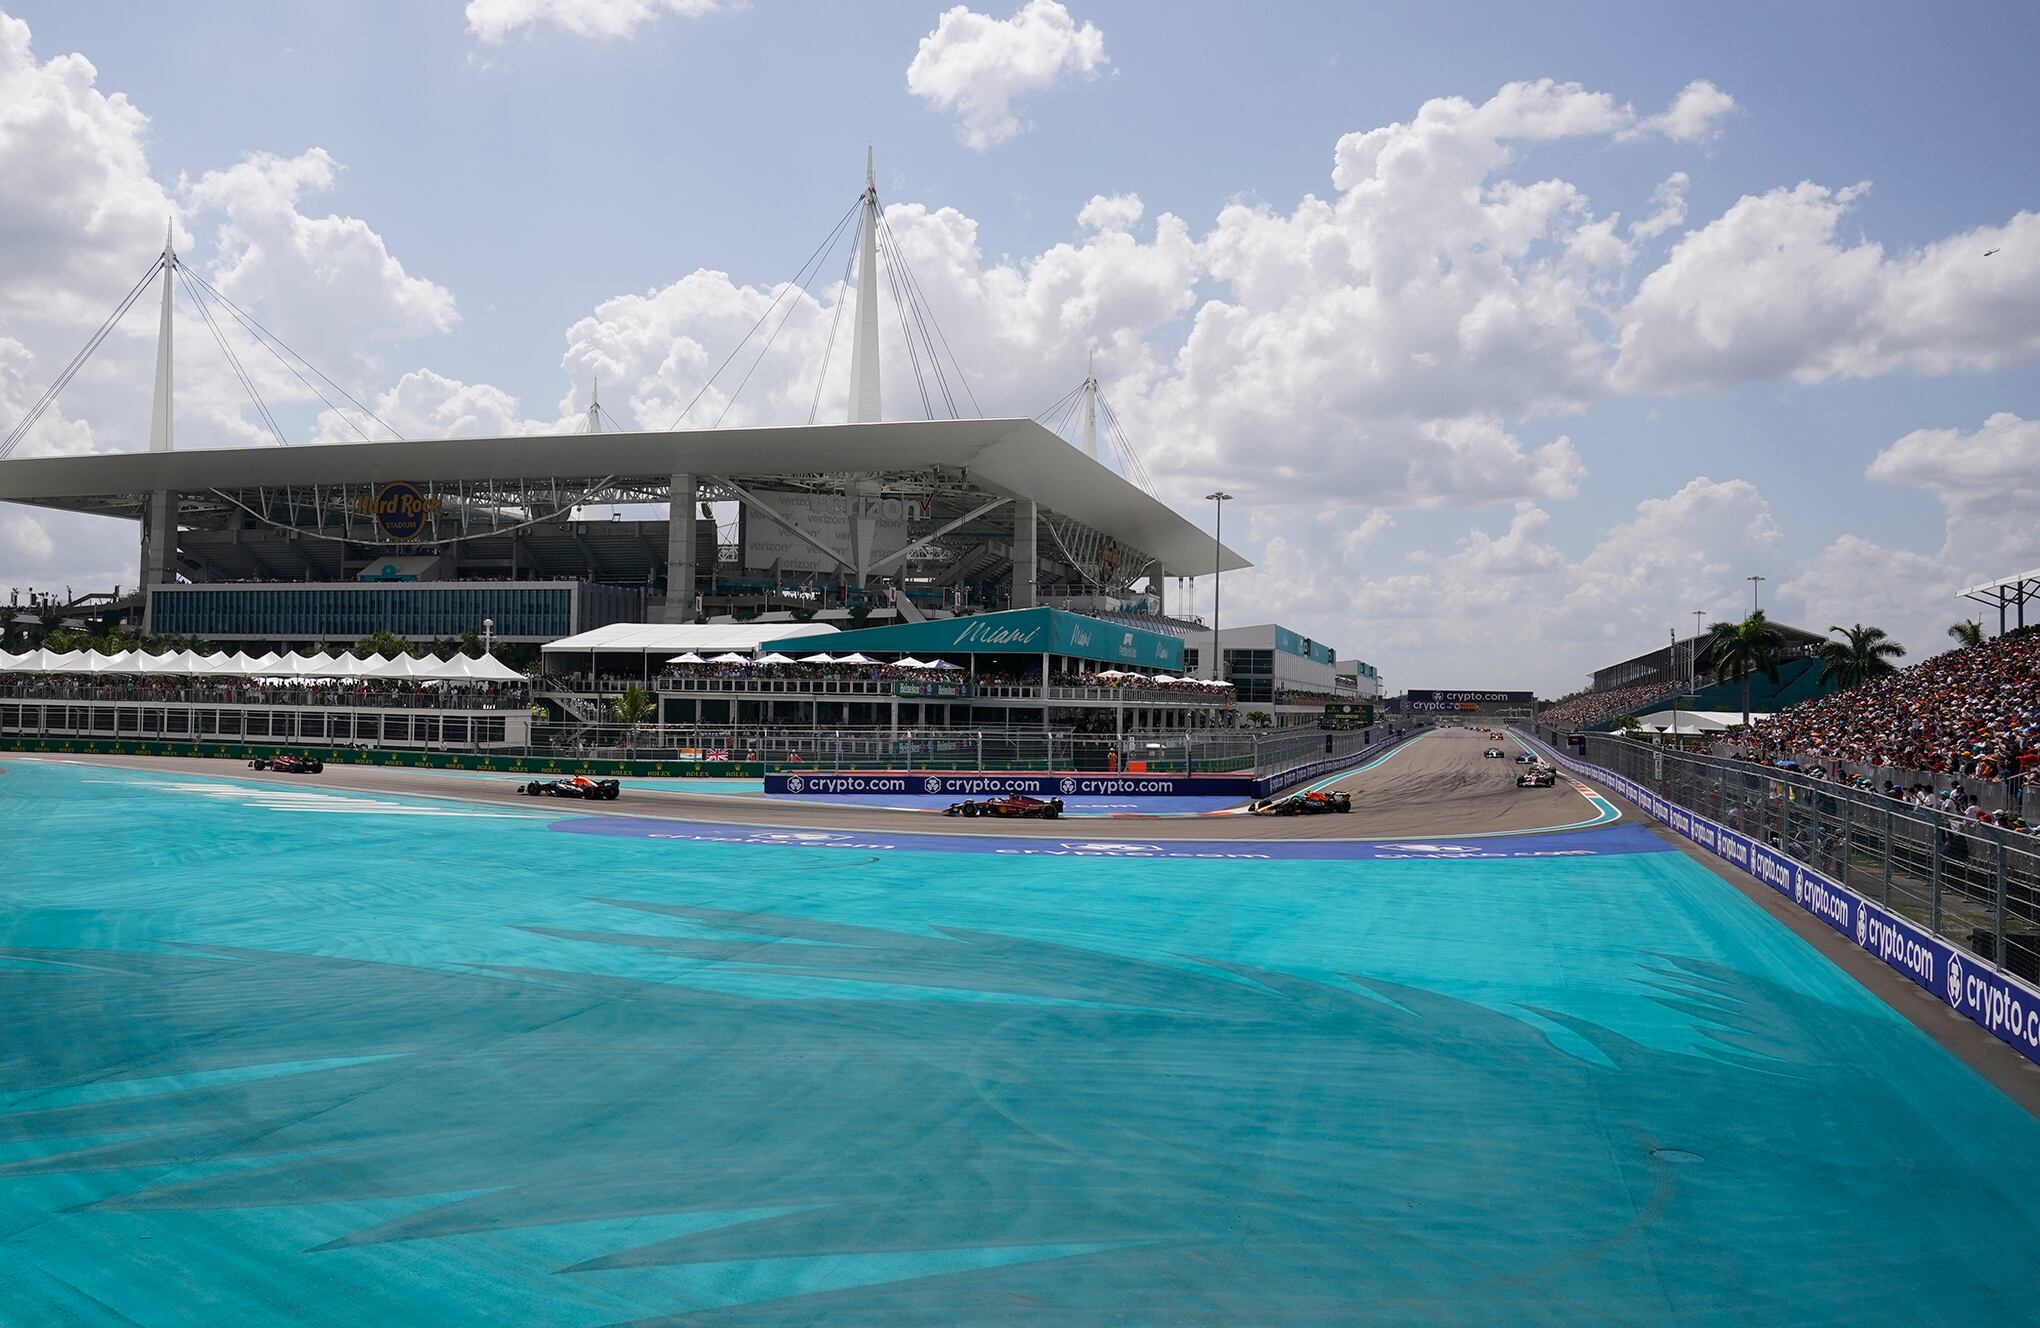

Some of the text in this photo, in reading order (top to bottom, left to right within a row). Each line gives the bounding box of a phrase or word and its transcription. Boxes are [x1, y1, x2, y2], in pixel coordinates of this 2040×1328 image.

[355, 494, 442, 517] Hard Rock
[386, 521, 417, 529] STADIUM
[784, 558, 816, 568] erizon
[953, 620, 1041, 646] Miami
[1446, 692, 1508, 702] crypto.com
[809, 777, 1173, 794] crypto.com crypto.com crypto.com
[1722, 836, 1747, 865] crypto.com
[1756, 853, 1790, 890] crypto.com
[1804, 879, 1848, 927] crypto.com
[1869, 917, 1934, 982] crypto.com
[1967, 975, 2040, 1047] crypto.c
